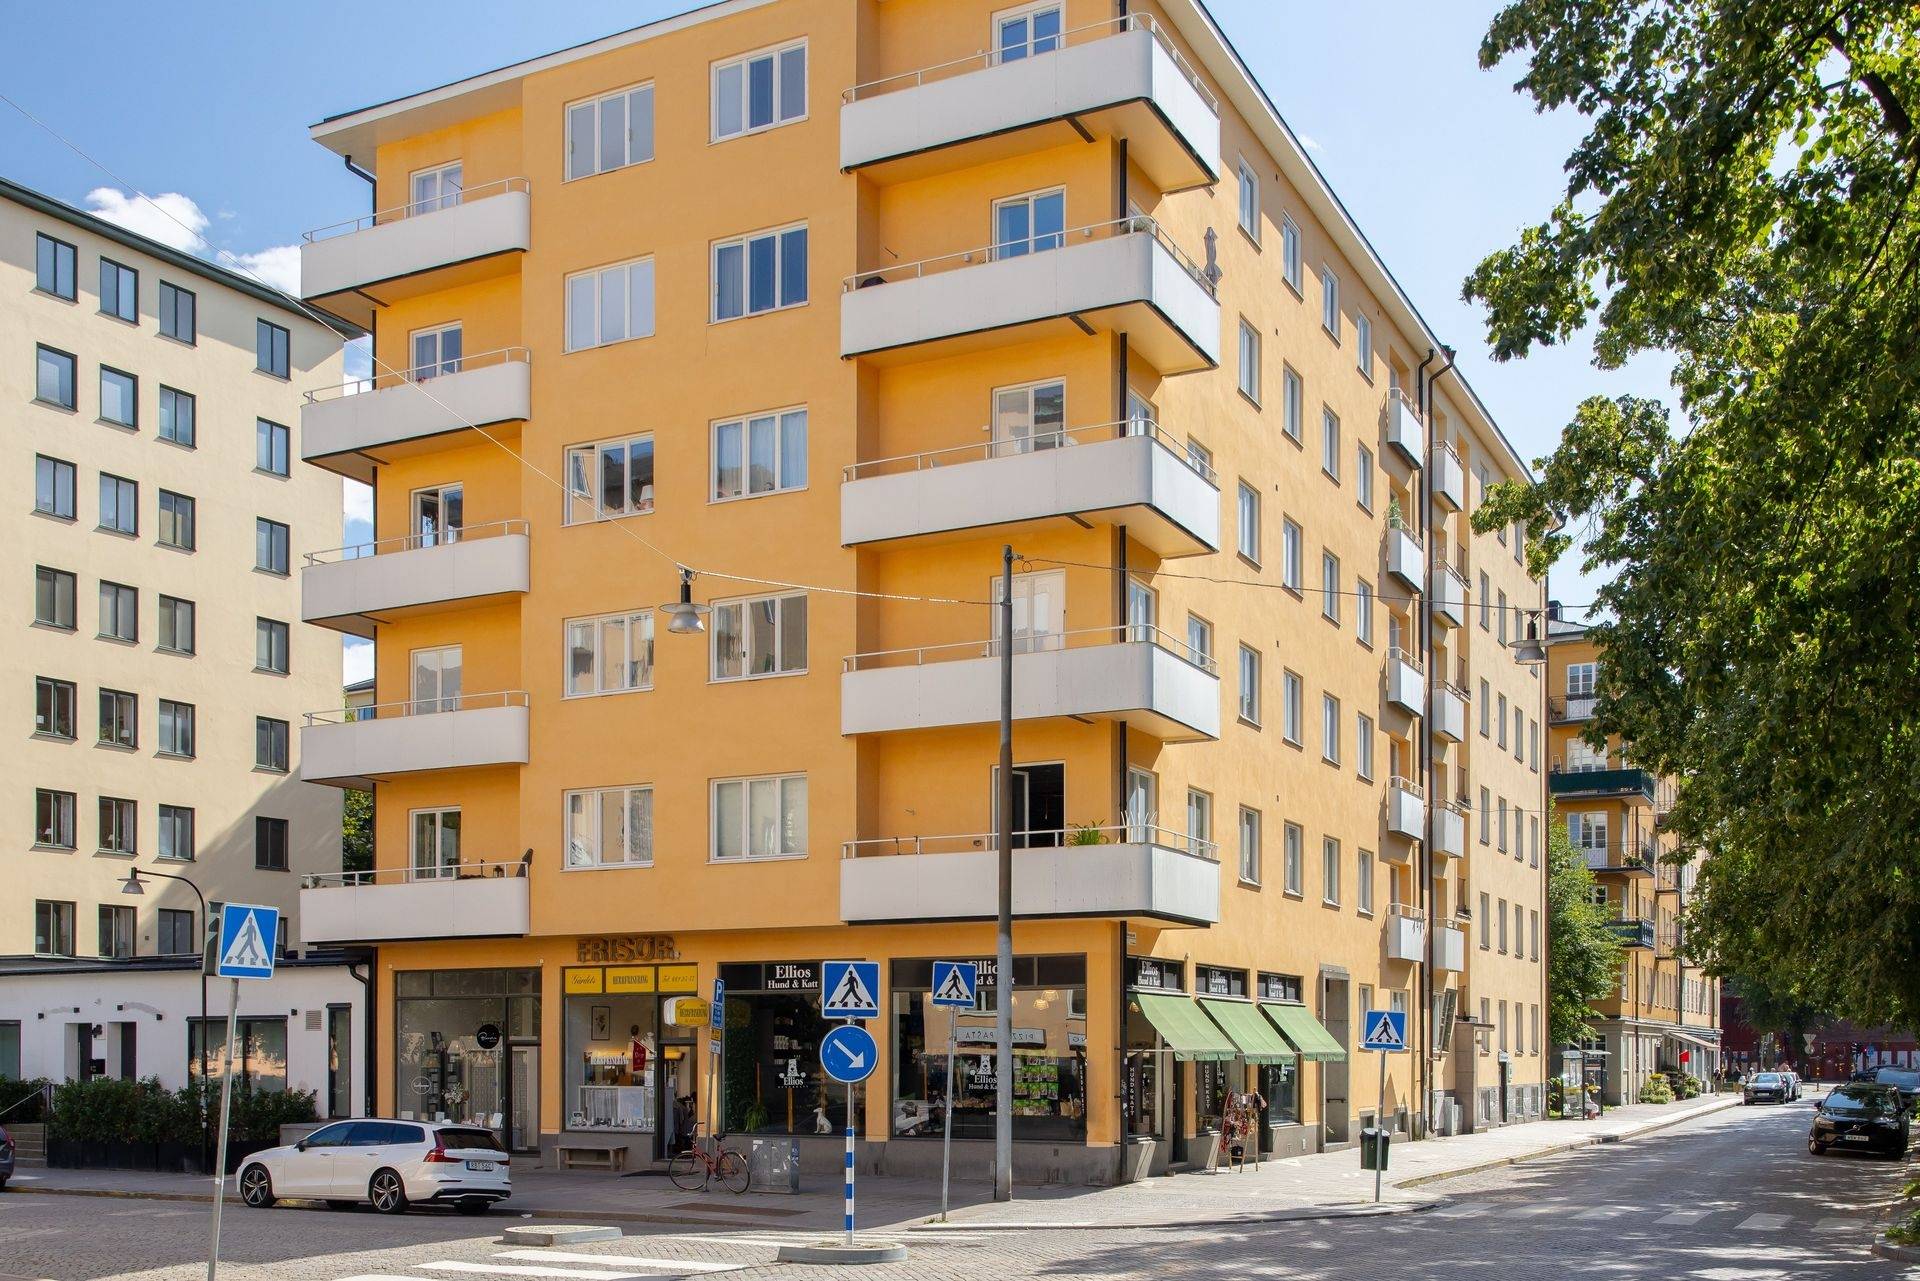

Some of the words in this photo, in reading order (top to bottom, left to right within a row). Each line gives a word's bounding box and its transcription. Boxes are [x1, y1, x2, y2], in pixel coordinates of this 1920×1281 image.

[775, 965, 811, 979] Ellios
[968, 960, 998, 974] llio
[768, 980, 790, 989] Hund
[792, 980, 799, 988] &
[801, 979, 818, 988] Katt
[986, 976, 995, 985] &
[716, 981, 723, 1001] P
[783, 1077, 804, 1086] Ellios
